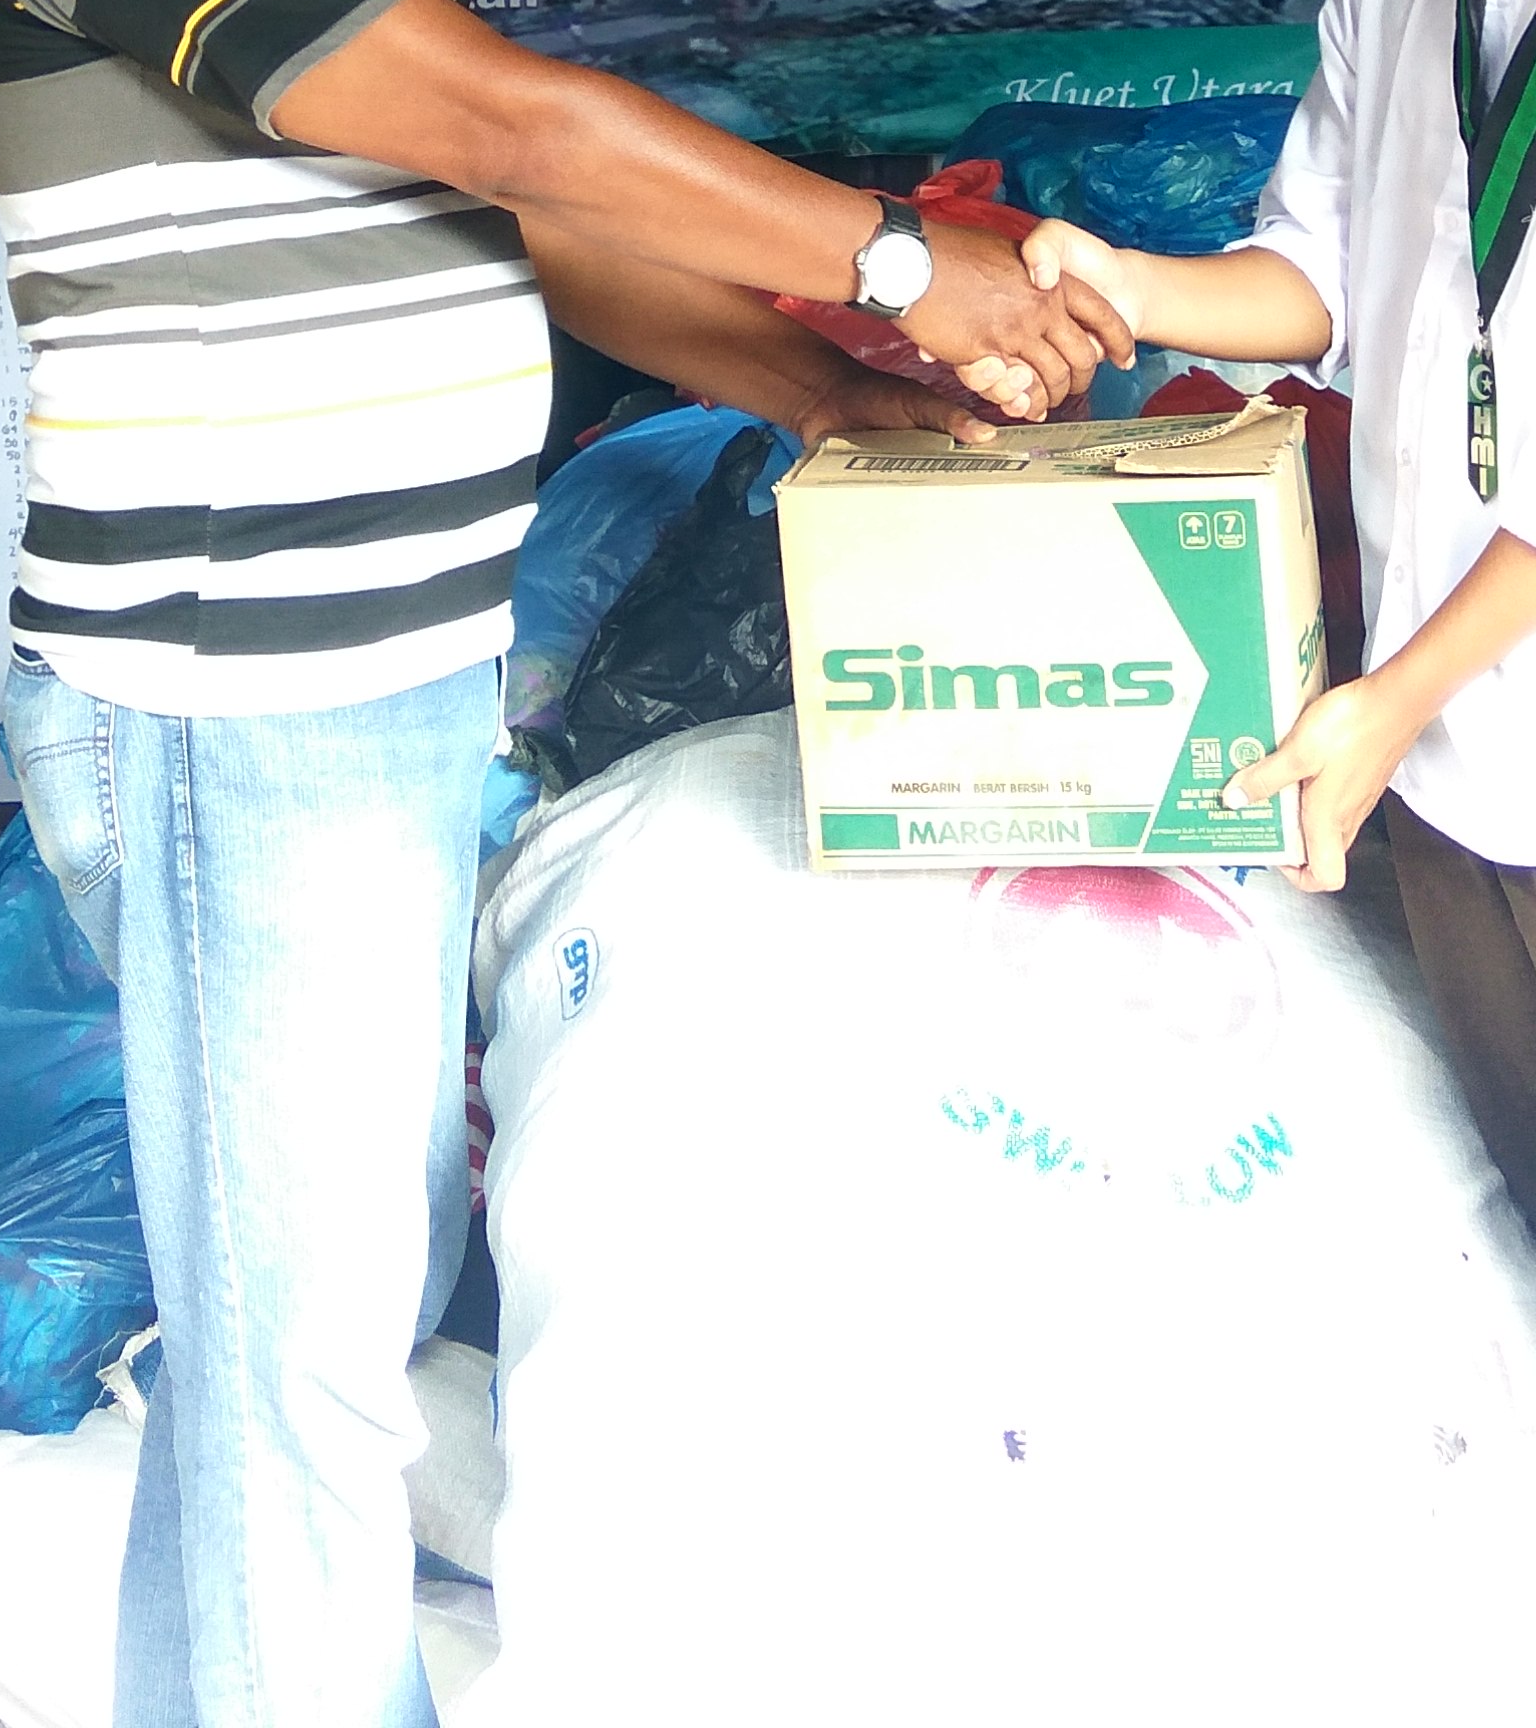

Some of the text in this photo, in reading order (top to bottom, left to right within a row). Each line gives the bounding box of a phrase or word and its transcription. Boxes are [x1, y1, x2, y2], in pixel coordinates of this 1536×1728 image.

[1470, 405, 1496, 496] HMI
[822, 644, 1175, 711] Simas
[1191, 742, 1222, 763] SNI
[891, 780, 1092, 795] MARGARIN BERAT BERSIH 15 kg
[909, 820, 1080, 845] MARGARIN
